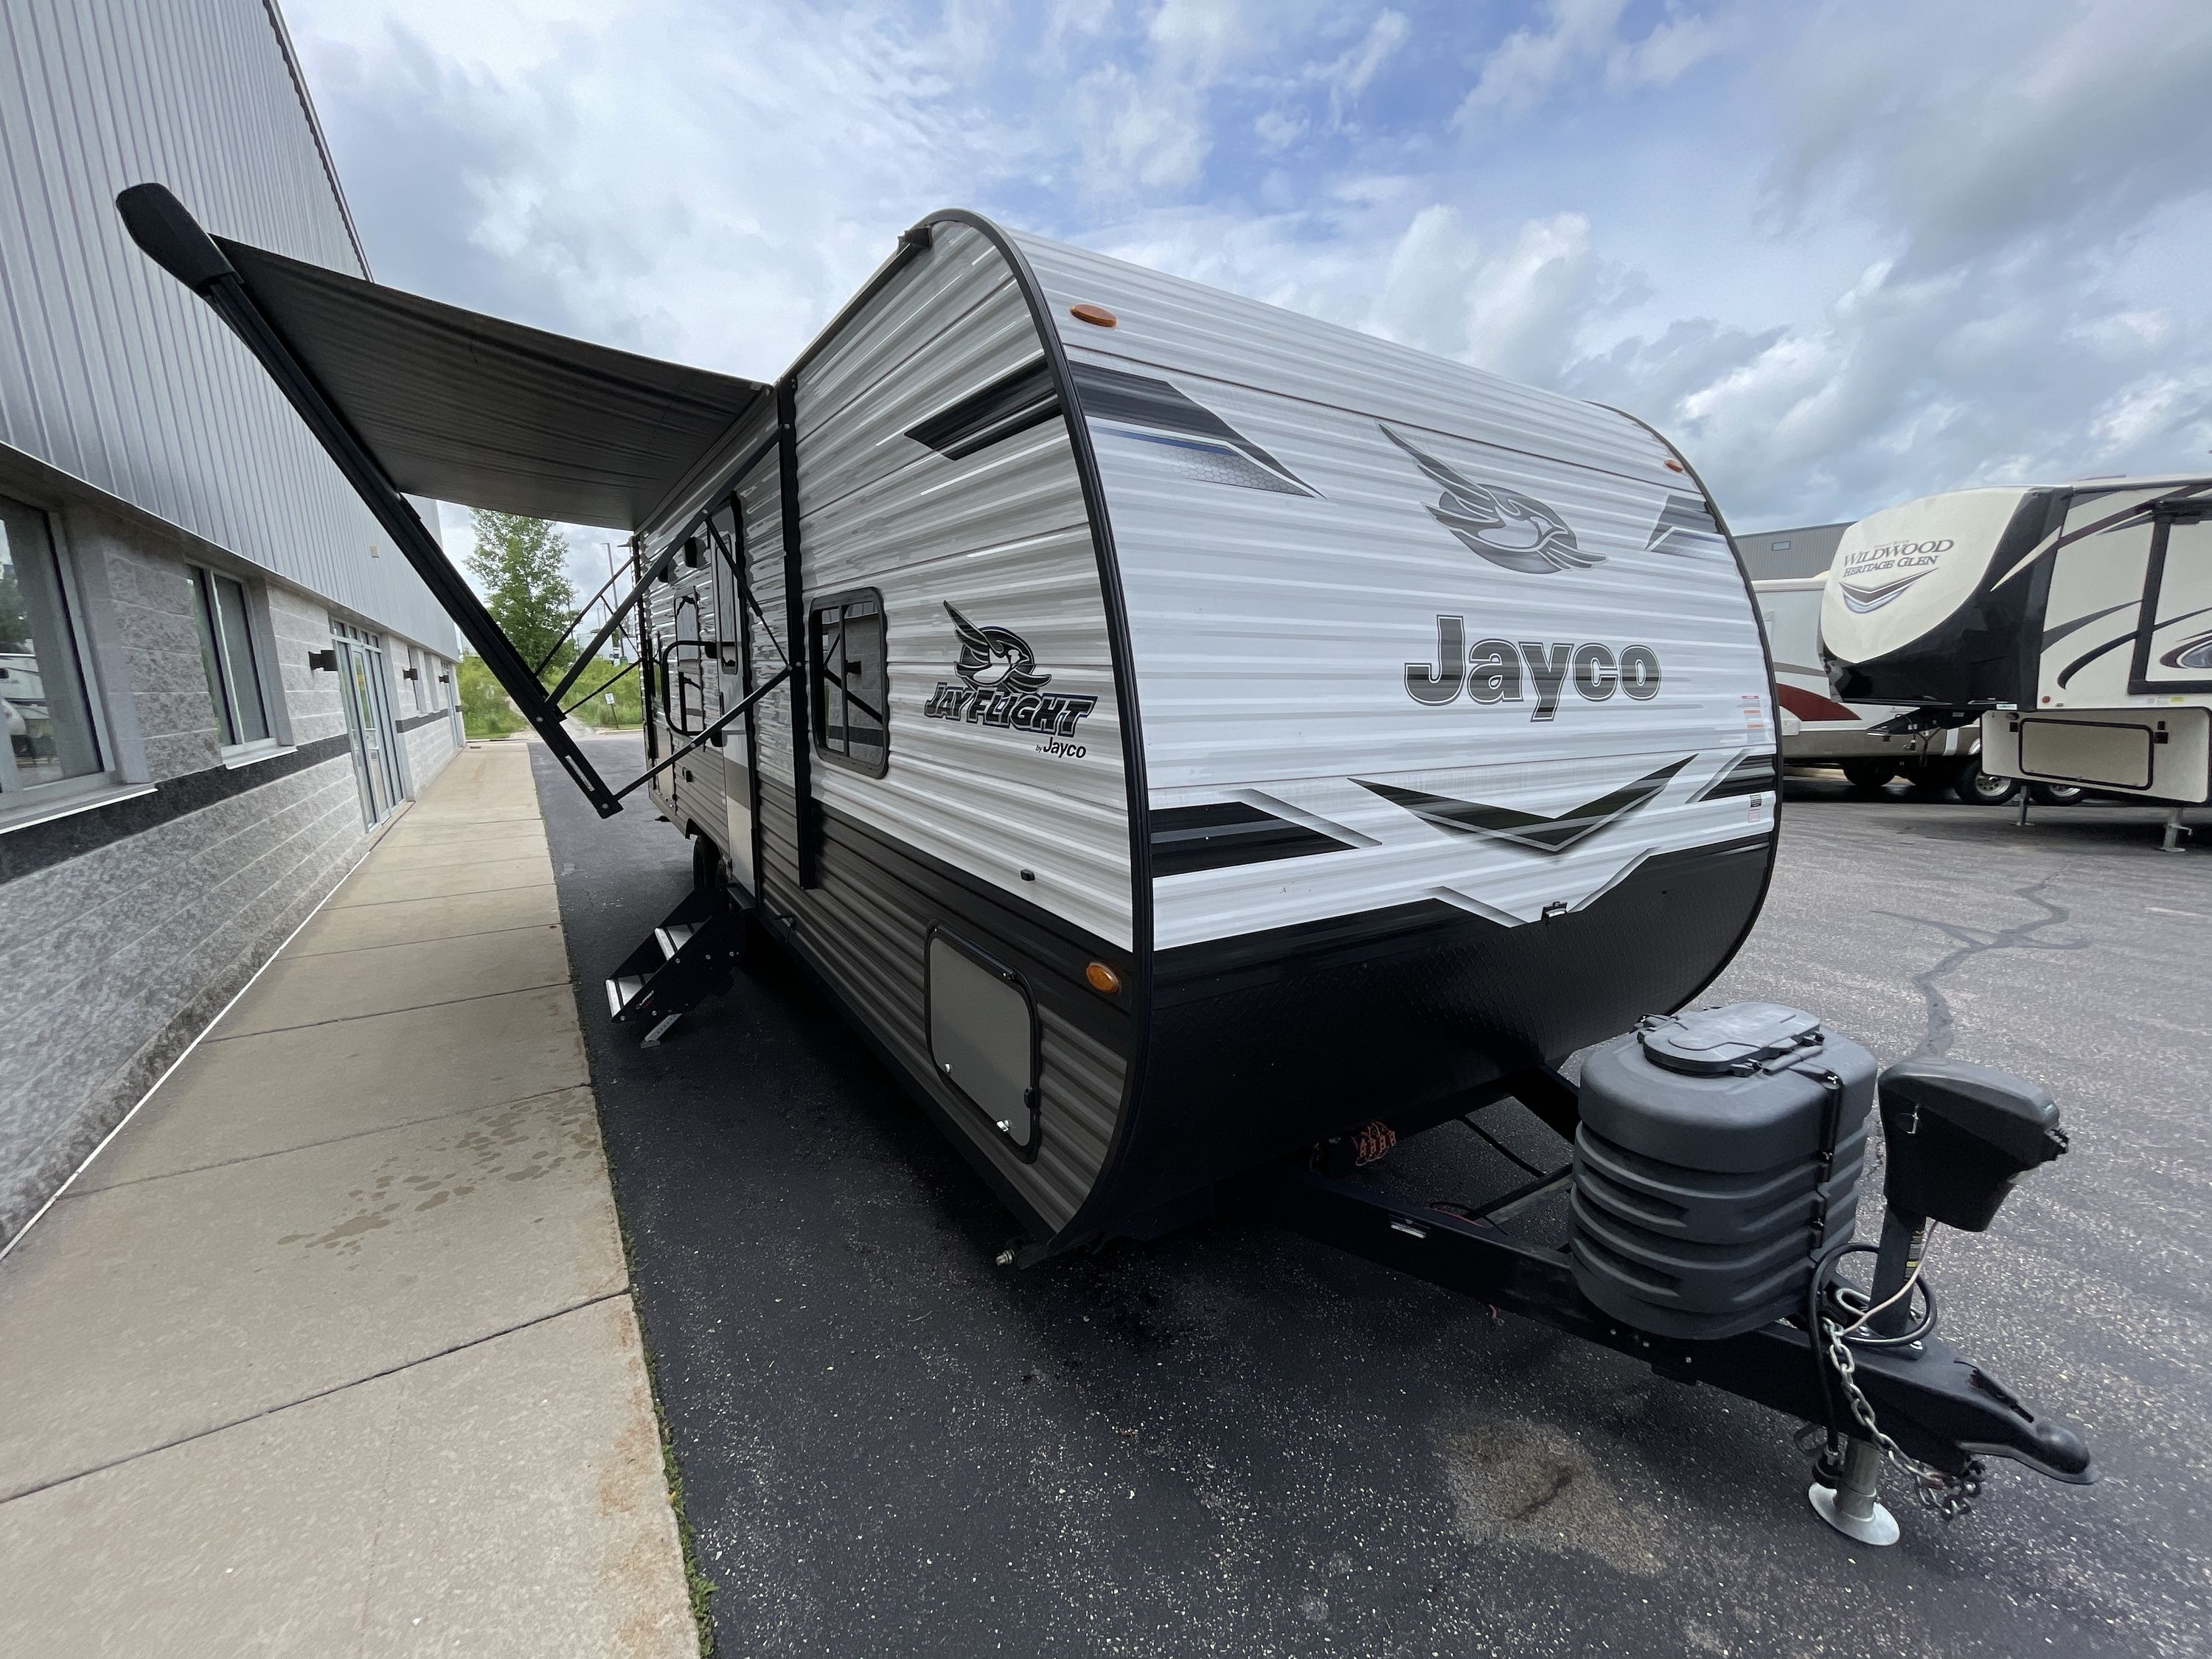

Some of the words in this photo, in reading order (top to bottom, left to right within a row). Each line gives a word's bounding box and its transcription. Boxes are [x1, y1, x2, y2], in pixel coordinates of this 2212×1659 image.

[1843, 539, 1955, 567] WILDWOOD
[1843, 559, 1895, 578] HERITAGE
[1896, 554, 1940, 568] GLEN
[1404, 614, 1661, 722] Jayco
[924, 682, 973, 722] JAY
[966, 687, 1098, 738] FLIGHT
[1035, 744, 1043, 753] by
[1043, 737, 1087, 759] Jayco
